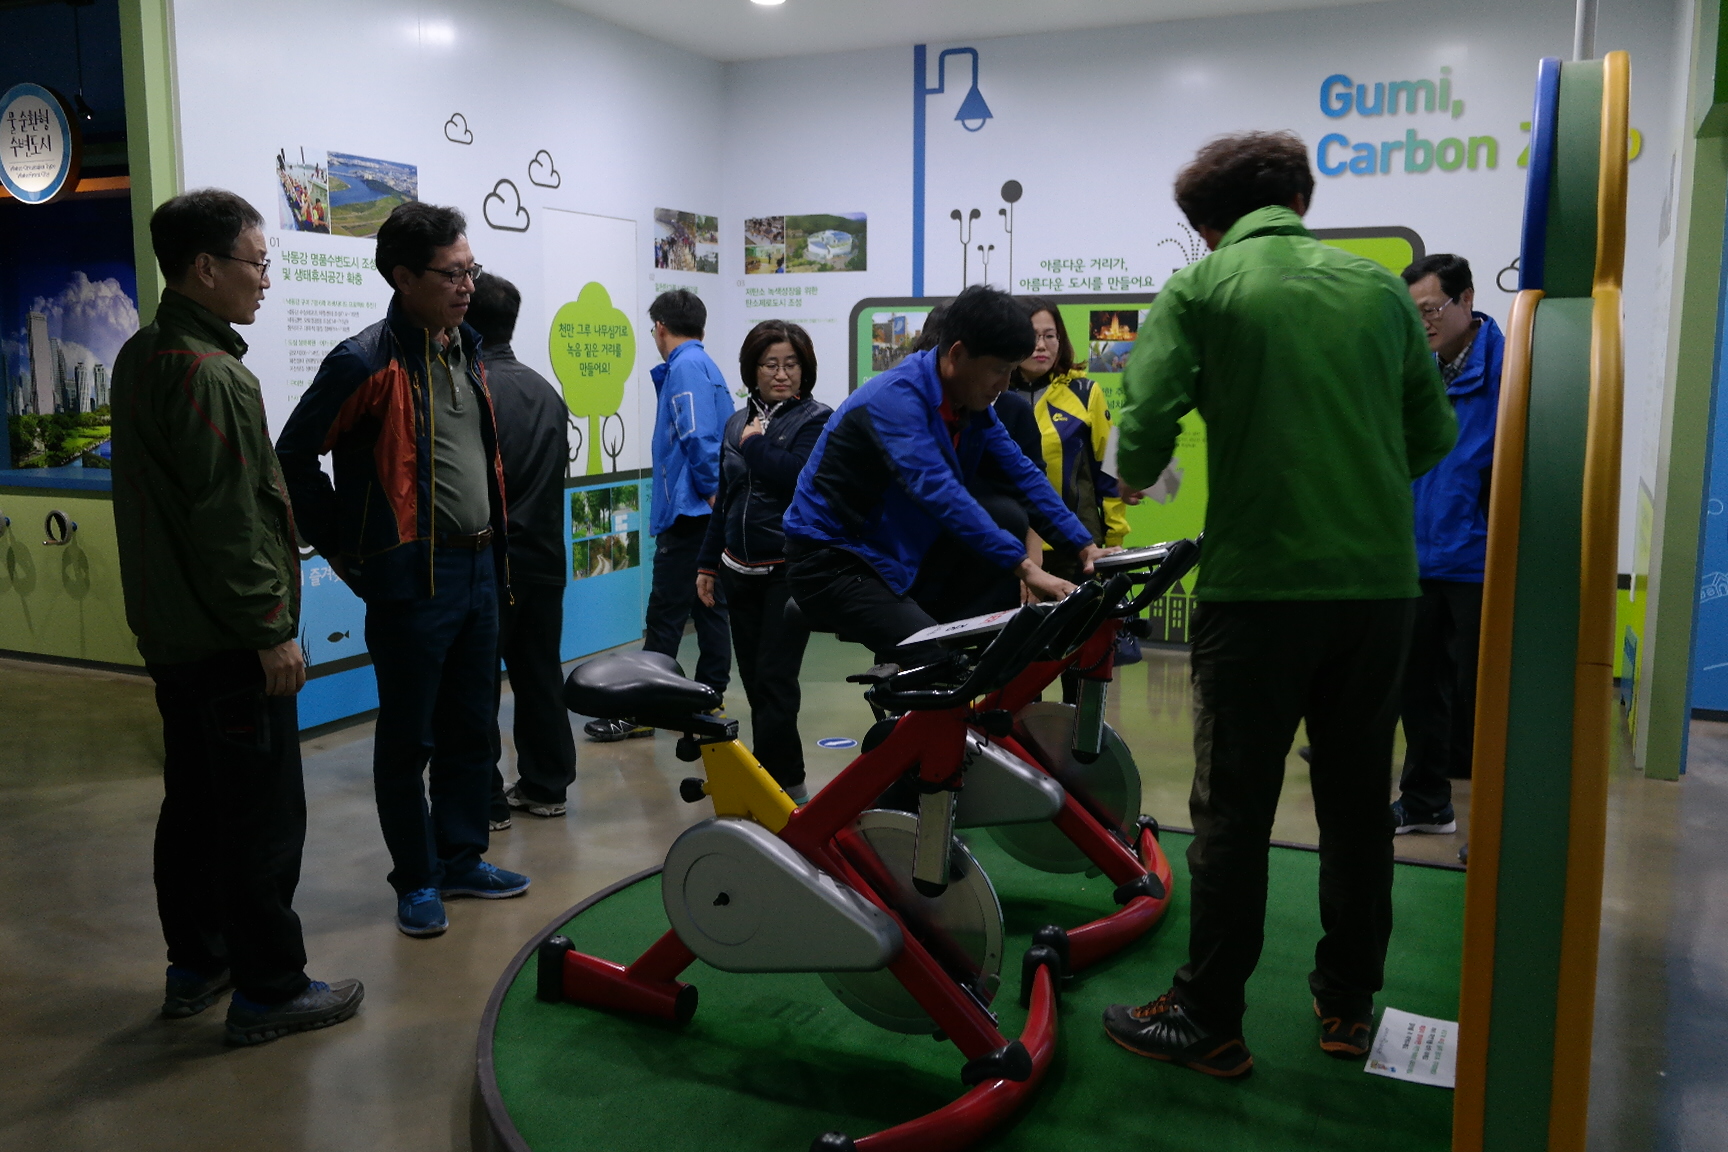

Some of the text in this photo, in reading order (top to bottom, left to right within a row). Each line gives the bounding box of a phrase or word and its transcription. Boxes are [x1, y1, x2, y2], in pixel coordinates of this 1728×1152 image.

[1320, 66, 1463, 119] Gumi,
[10, 134, 51, 157] 수변도시
[1317, 128, 1497, 176] Carbon
[270, 237, 280, 247] 01
[281, 250, 307, 265] 낙동강
[310, 253, 359, 269] 명품수변도시
[1040, 258, 1128, 273] 아름다운 거리가,
[282, 267, 363, 286] 및 생태휴식공간 확충
[1020, 276, 1154, 292] 아름다운 도시를 만들어요
[745, 286, 818, 296] 저탄소 녹색성장을 위한
[745, 299, 802, 308] 탄소제로도시 조성
[559, 323, 628, 339] 천만 그루 나무심기로
[567, 343, 621, 358] 녹음 짙은 거리를
[579, 362, 610, 377] 만들어요!
